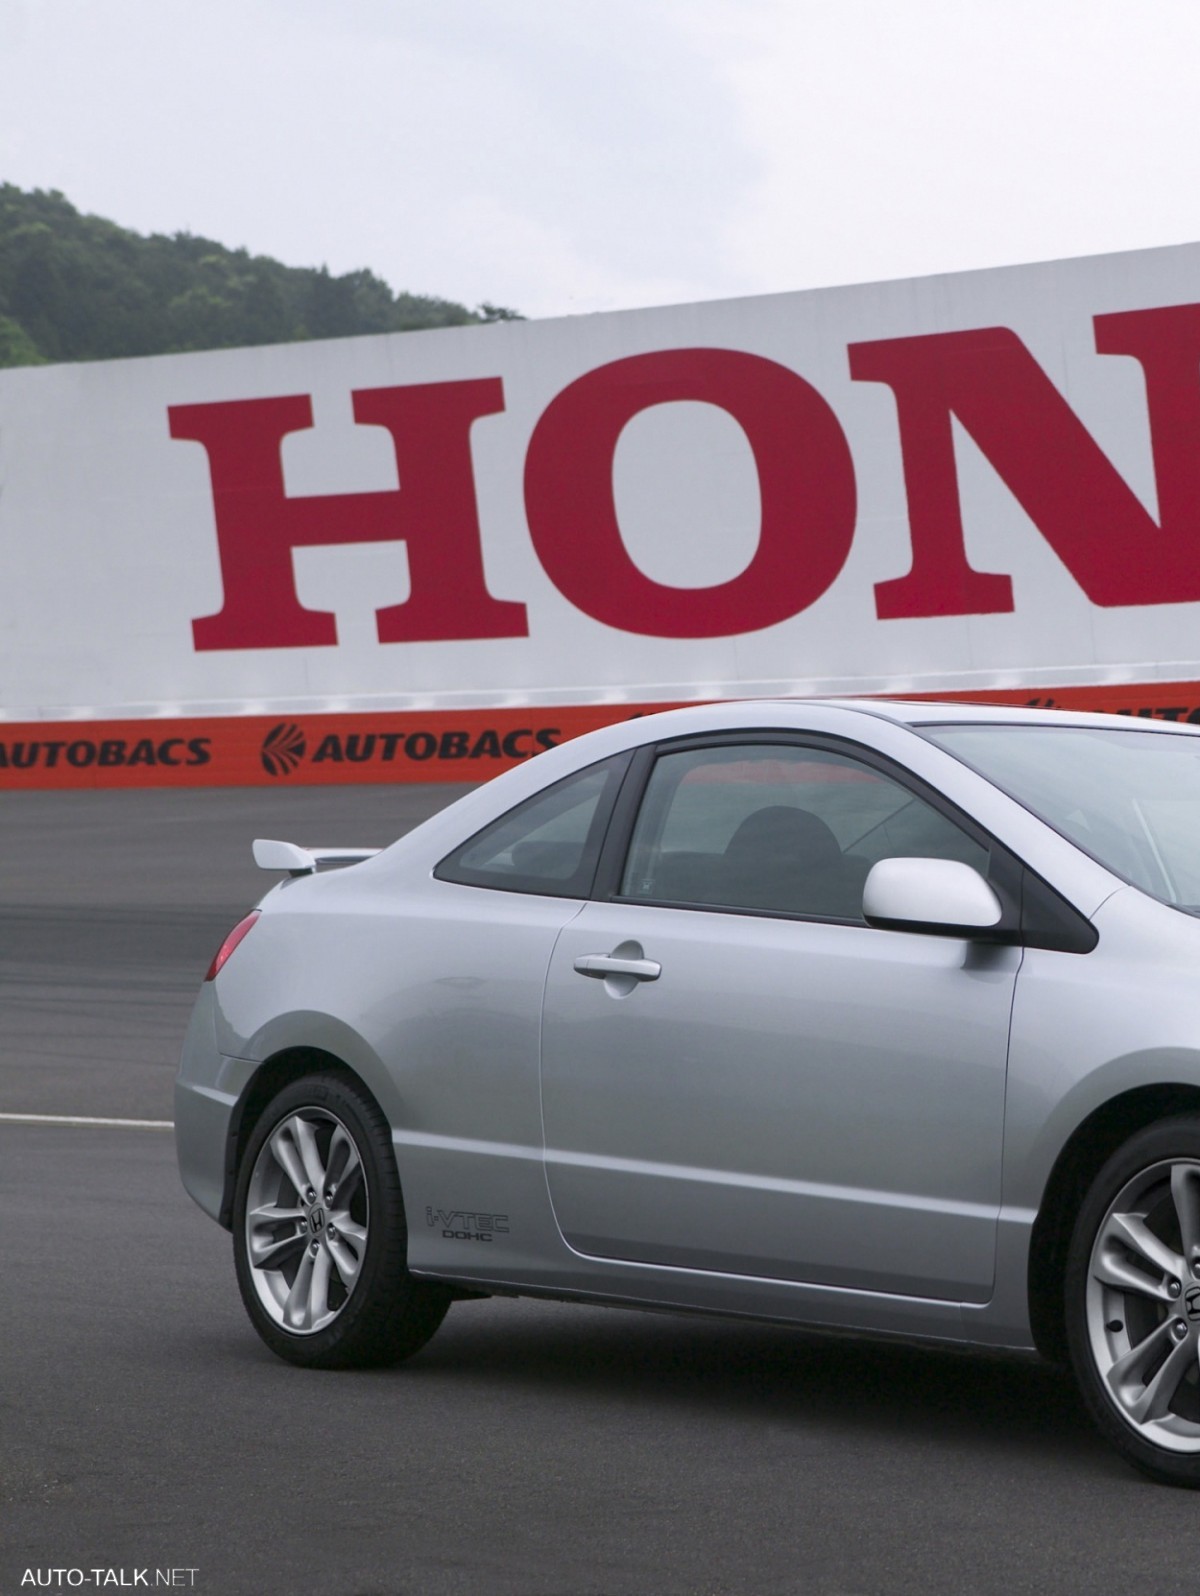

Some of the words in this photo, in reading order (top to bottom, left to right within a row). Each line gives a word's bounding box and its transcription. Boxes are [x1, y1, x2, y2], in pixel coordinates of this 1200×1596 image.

[311, 728, 561, 762] AUTOBACS
[426, 1206, 510, 1233] i-VTEC
[442, 1229, 493, 1242] DOHC
